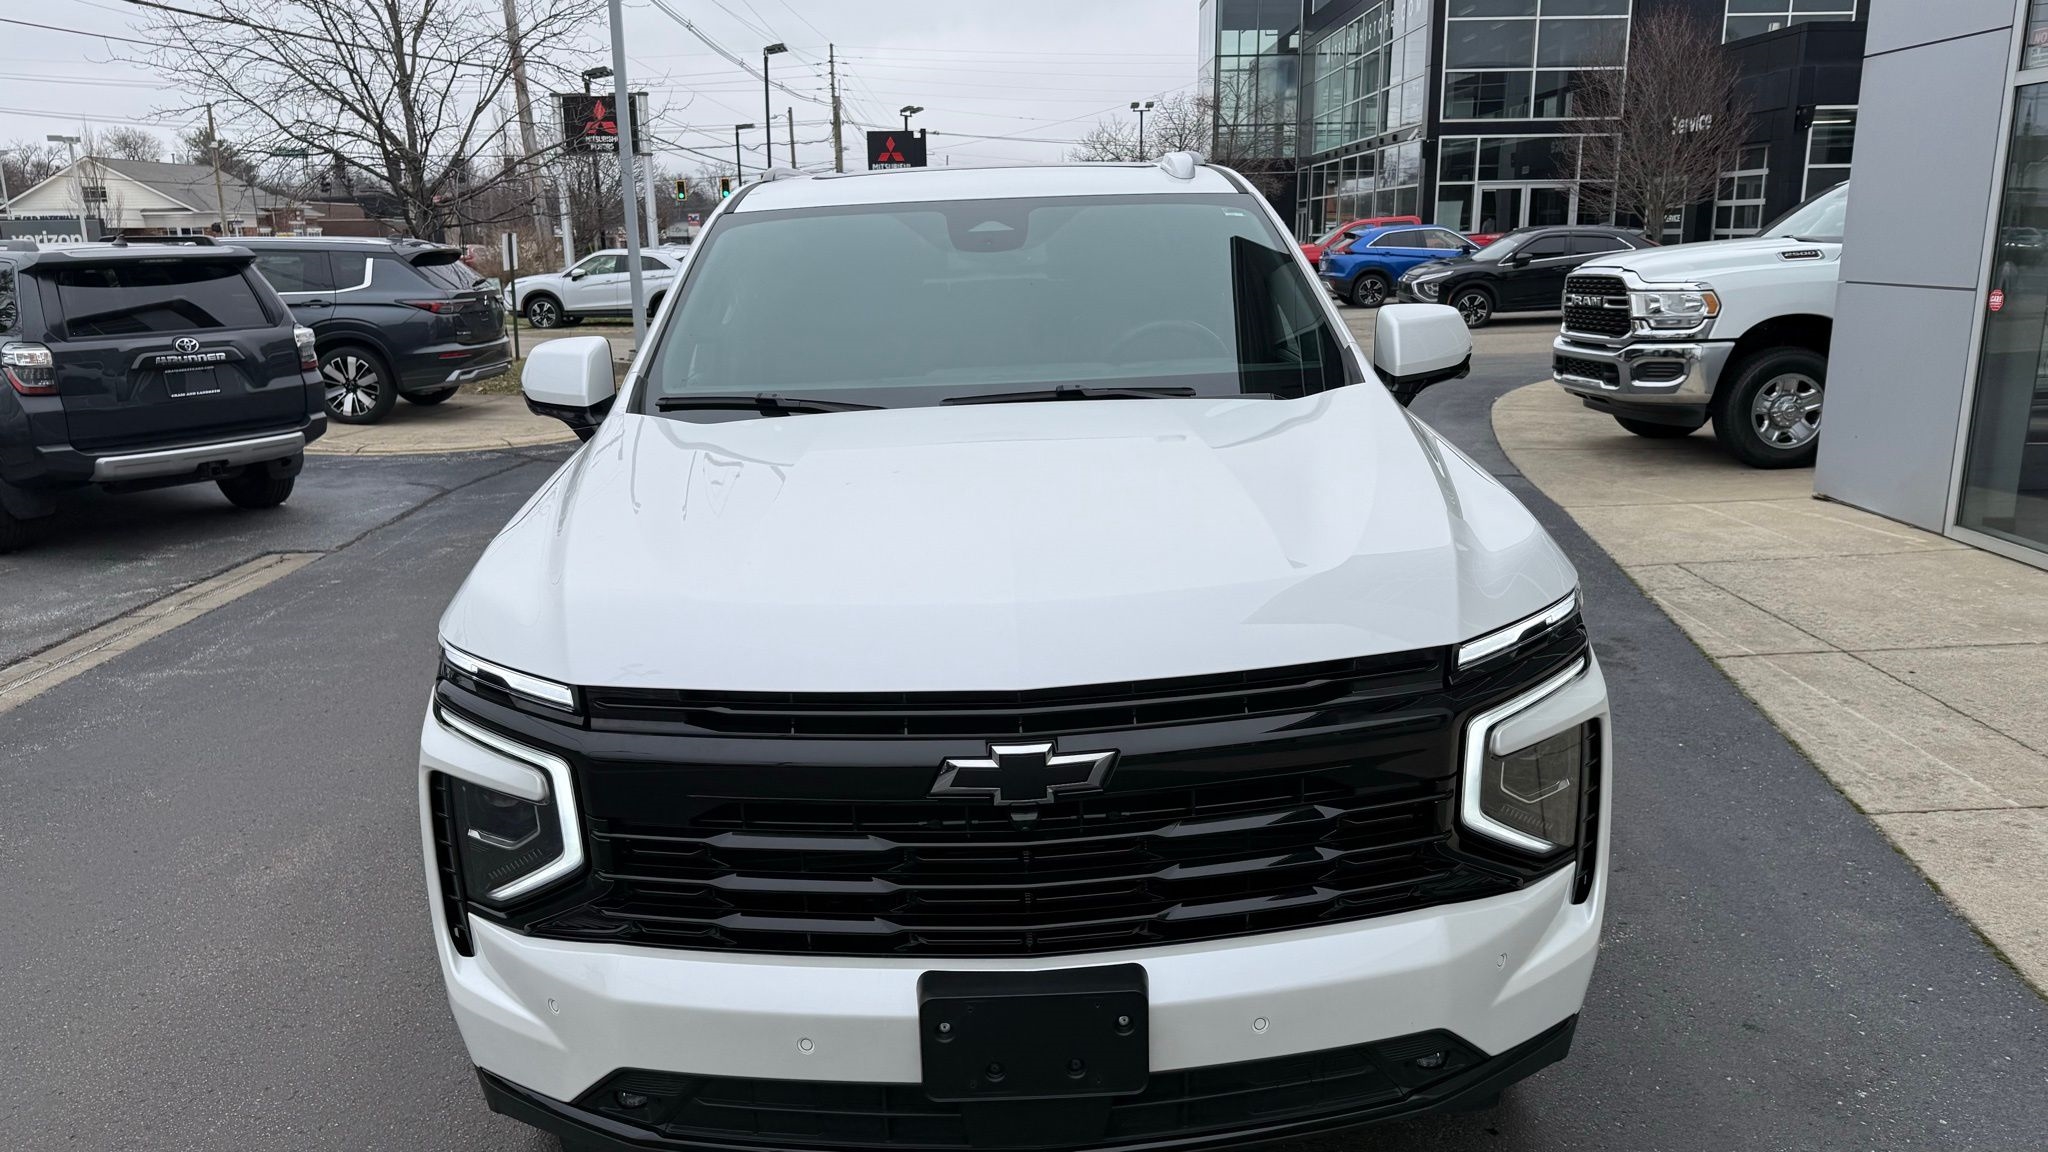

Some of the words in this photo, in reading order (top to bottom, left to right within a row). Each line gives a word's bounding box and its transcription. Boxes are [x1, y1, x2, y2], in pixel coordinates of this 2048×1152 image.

[1671, 111, 1713, 135] Service
[1572, 295, 1602, 307] RAM
[156, 353, 226, 364] 4RUNNER
